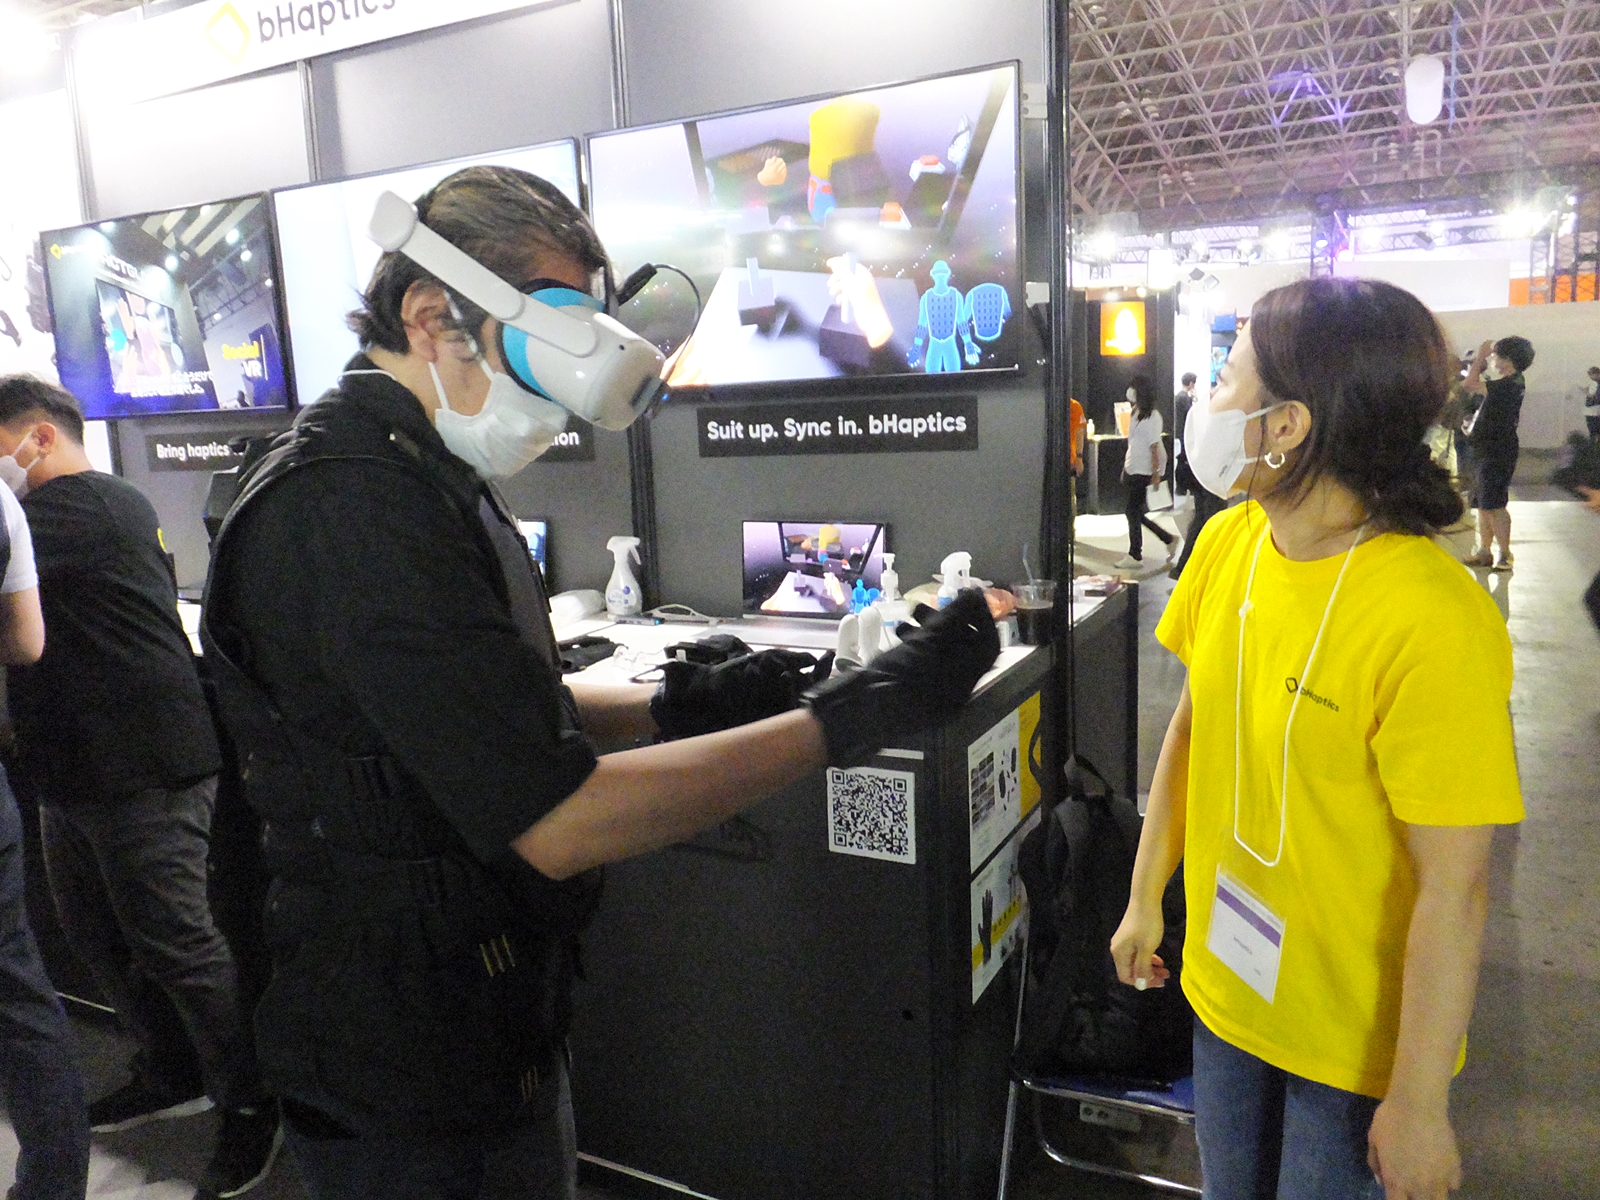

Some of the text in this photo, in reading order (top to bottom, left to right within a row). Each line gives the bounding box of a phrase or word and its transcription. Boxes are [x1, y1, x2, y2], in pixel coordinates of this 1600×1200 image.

[221, 341, 260, 360] Social
[242, 360, 262, 377] VR
[707, 412, 967, 442] Suit up. Sync in. bHaptics
[156, 441, 230, 461] Bring haptics
